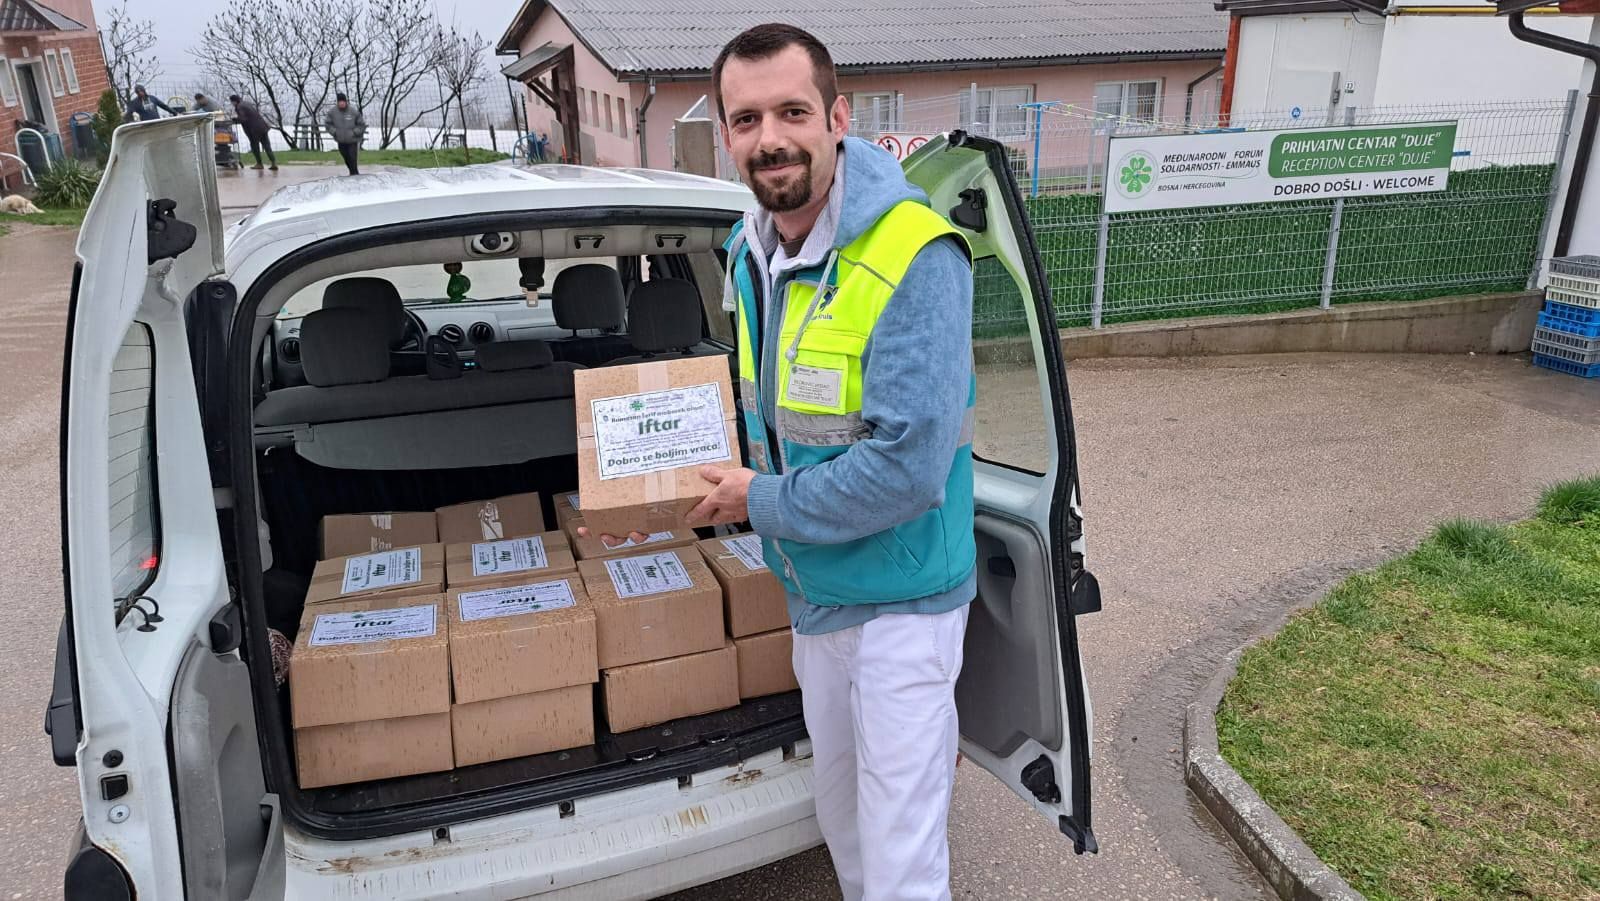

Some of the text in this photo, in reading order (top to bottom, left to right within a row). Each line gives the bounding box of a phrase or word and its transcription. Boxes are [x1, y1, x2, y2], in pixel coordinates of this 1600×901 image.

[1281, 132, 1441, 154] PRIHVATNI CENTAR "DUJE"
[1163, 149, 1263, 163] MEĐUNARODNI FORUM
[1281, 150, 1436, 172] RECEPTION CENTER "DUJE"
[1160, 162, 1221, 174] SOLIDARNOSTI
[1225, 160, 1261, 170] EMMAUS
[1157, 183, 1179, 192] BOSNA
[1183, 181, 1226, 191] HERCEGOVINA
[1273, 175, 1435, 196] DOBRO DOŠLI WELCOME
[638, 418, 681, 435] Iftar
[607, 456, 641, 467] Dobro
[643, 454, 653, 462] se
[655, 448, 688, 460] boljim
[354, 619, 397, 629] Iftar
